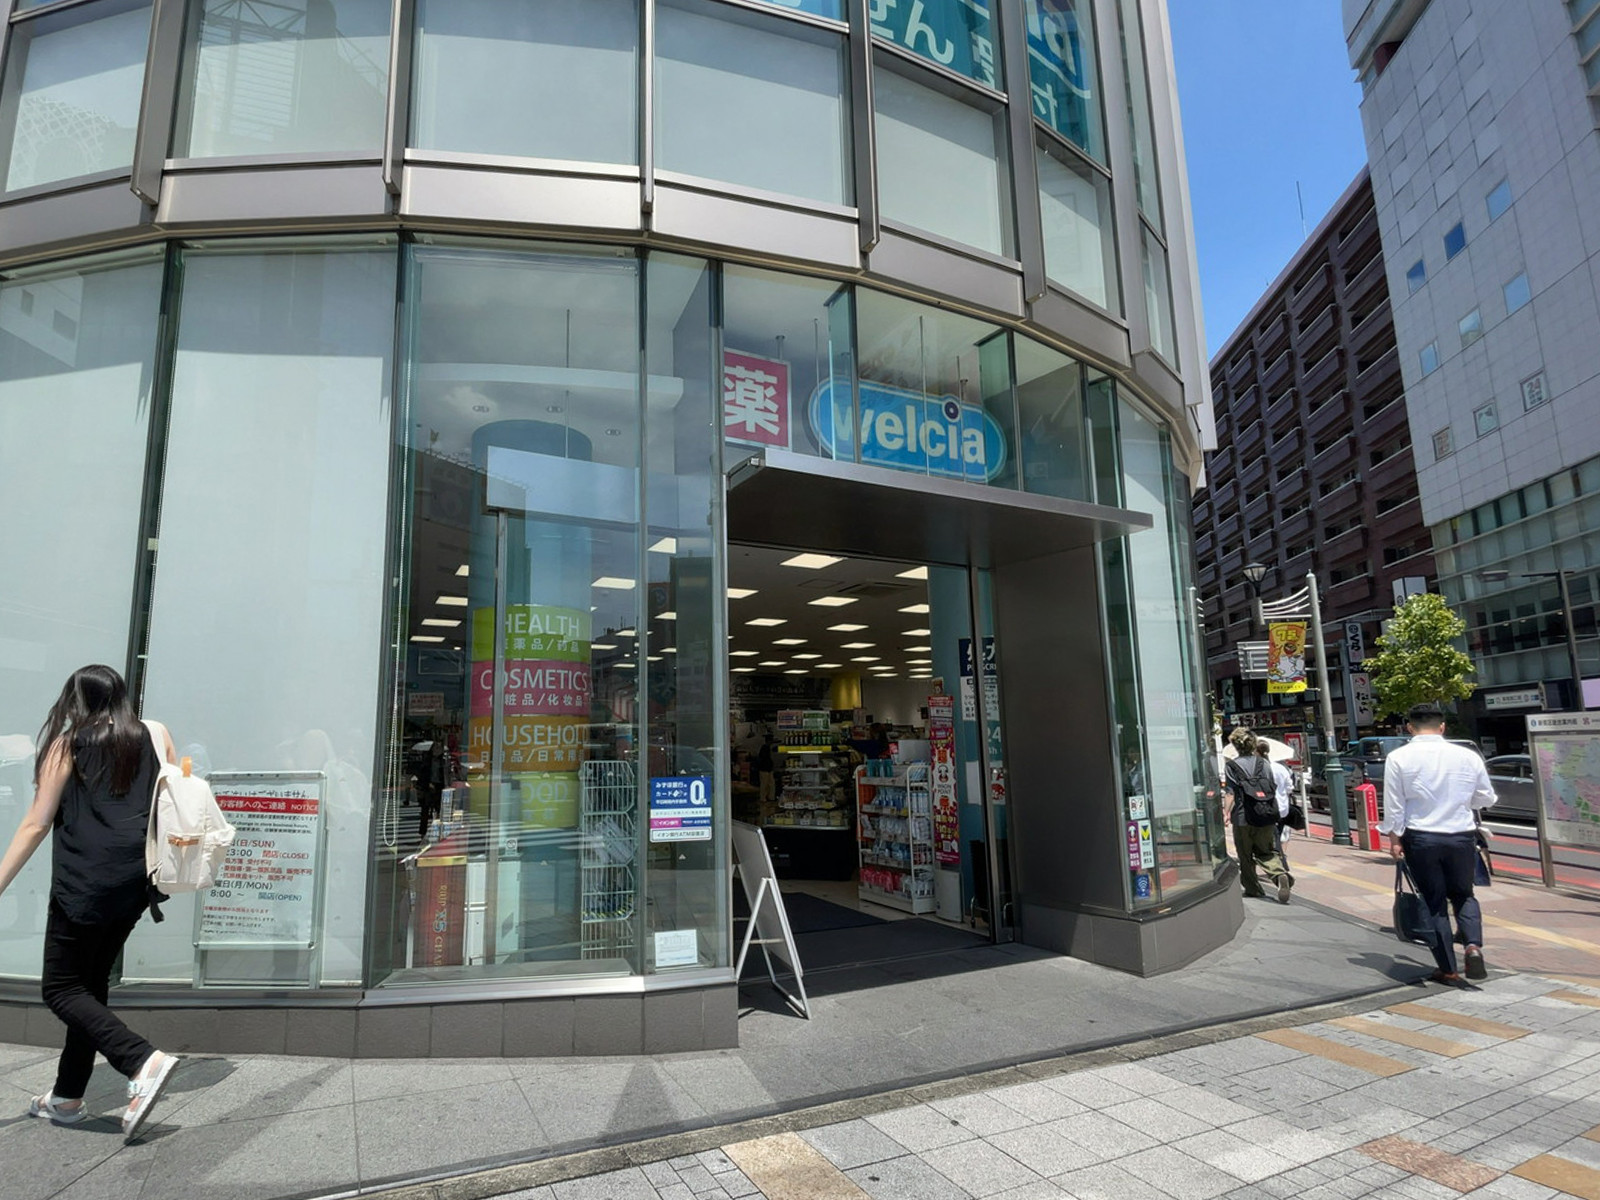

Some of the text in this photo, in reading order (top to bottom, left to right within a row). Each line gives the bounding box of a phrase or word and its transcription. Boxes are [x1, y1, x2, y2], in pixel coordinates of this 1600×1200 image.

[724, 366, 780, 436] 薬
[834, 399, 986, 465] welcia
[505, 612, 580, 638] HEALTH
[218, 800, 286, 811] お客様へのご連絡
